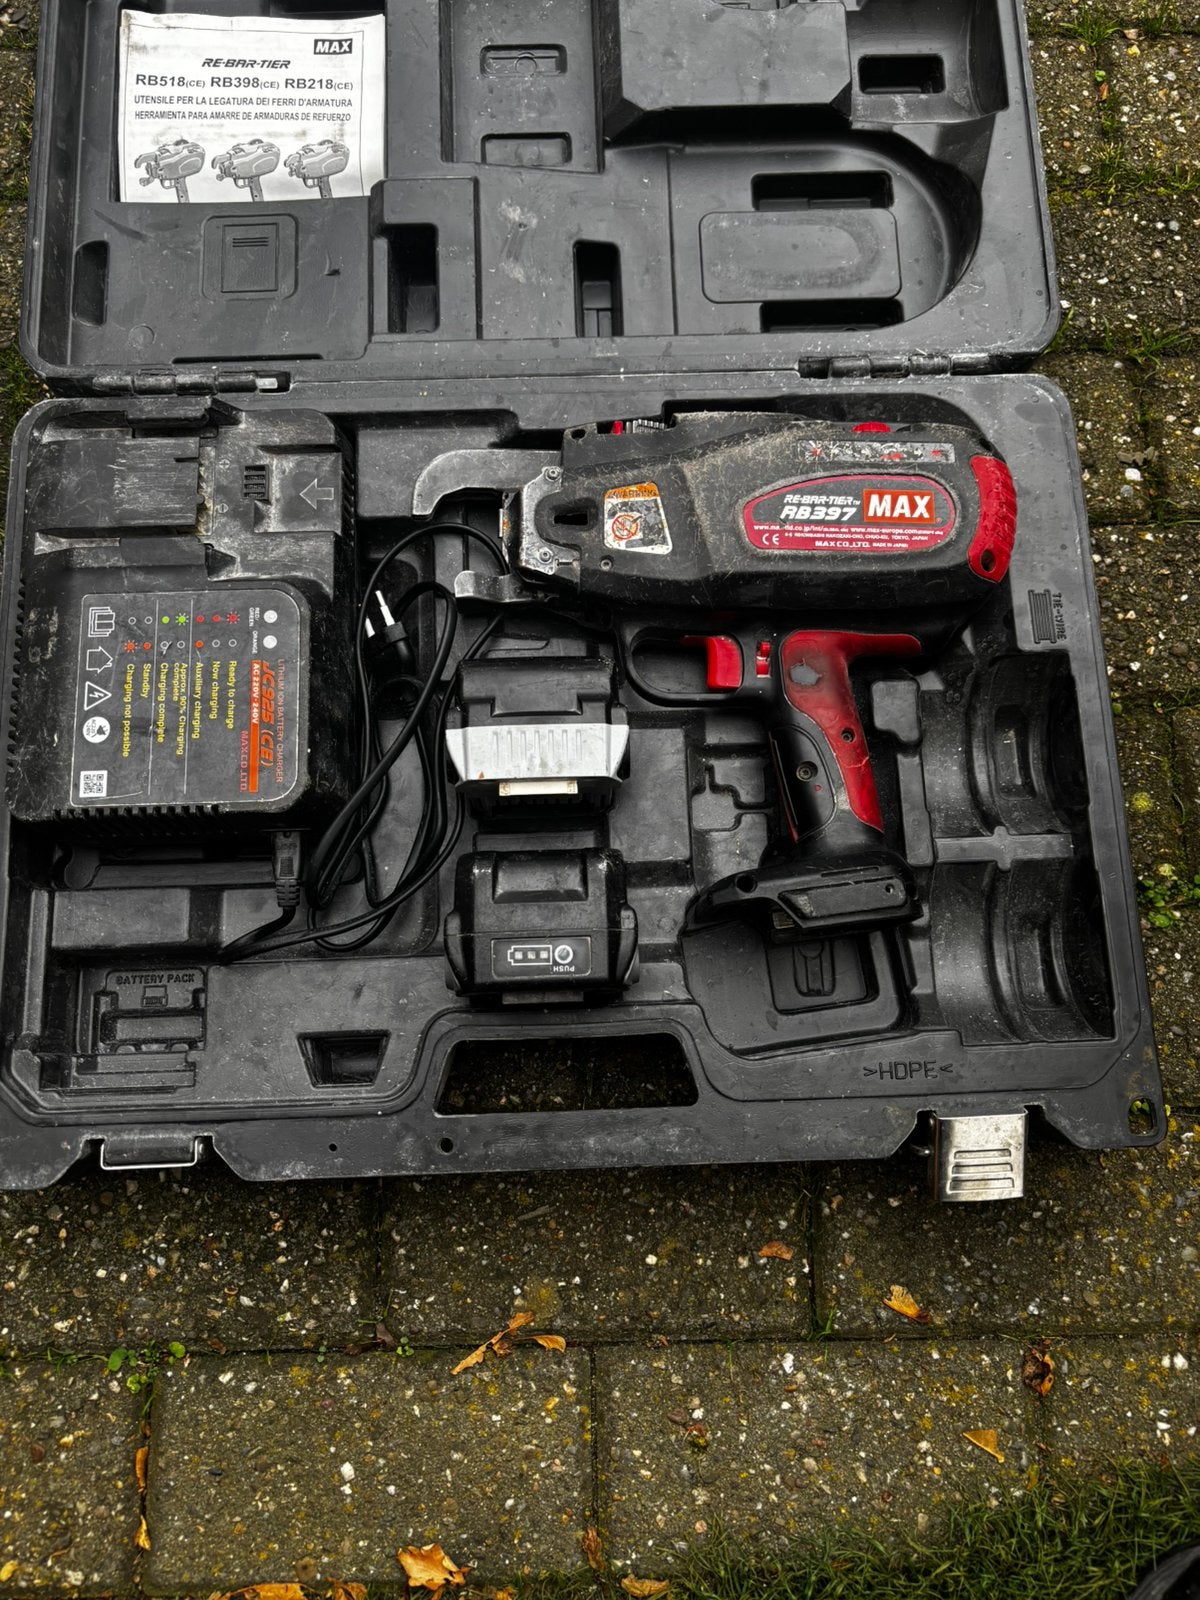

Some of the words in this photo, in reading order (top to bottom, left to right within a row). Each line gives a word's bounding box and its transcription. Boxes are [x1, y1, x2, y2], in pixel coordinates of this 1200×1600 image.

[315, 40, 351, 54] MAX
[136, 74, 206, 89] RB518(CE)
[210, 76, 280, 90] RB398(CE)
[284, 78, 354, 91] RB218(CE)
[134, 95, 174, 104] UTENSILE
[176, 96, 194, 105] PER
[196, 97, 207, 106] LA
[209, 97, 254, 106] LEGATURA
[256, 98, 270, 106] DEI
[272, 98, 296, 107] FERRI
[298, 98, 353, 108] D'ARMATURA
[134, 110, 186, 120] HERRAMIENTA
[188, 111, 208, 120] PARA
[210, 112, 240, 120] AMARRE
[242, 112, 252, 120] DE
[254, 112, 300, 121] ARMADURAS
[301, 112, 310, 121] DE
[312, 112, 352, 122] REFUERZO
[780, 505, 857, 521] RB397
[868, 494, 930, 518] MAX
[124, 664, 134, 702] Charging
[140, 664, 151, 698] Standby
[158, 662, 168, 701] Charging
[180, 663, 188, 695] Approx.
[194, 662, 204, 699] Auxiliary
[227, 660, 237, 687] Ready
[253, 663, 259, 676] AC
[277, 659, 286, 690] LITHIUM
[210, 682, 219, 720] charging
[228, 689, 236, 697] to
[262, 661, 275, 725] JC925
[157, 703, 167, 743] complete
[192, 701, 202, 739] charging
[226, 700, 235, 729] charge
[122, 720, 131, 758] possible
[176, 716, 186, 755] Charging
[260, 730, 274, 767] (CE)
[276, 743, 284, 782] CHARGER
[116, 974, 164, 985] BATTERY
[166, 973, 195, 984] PACK
